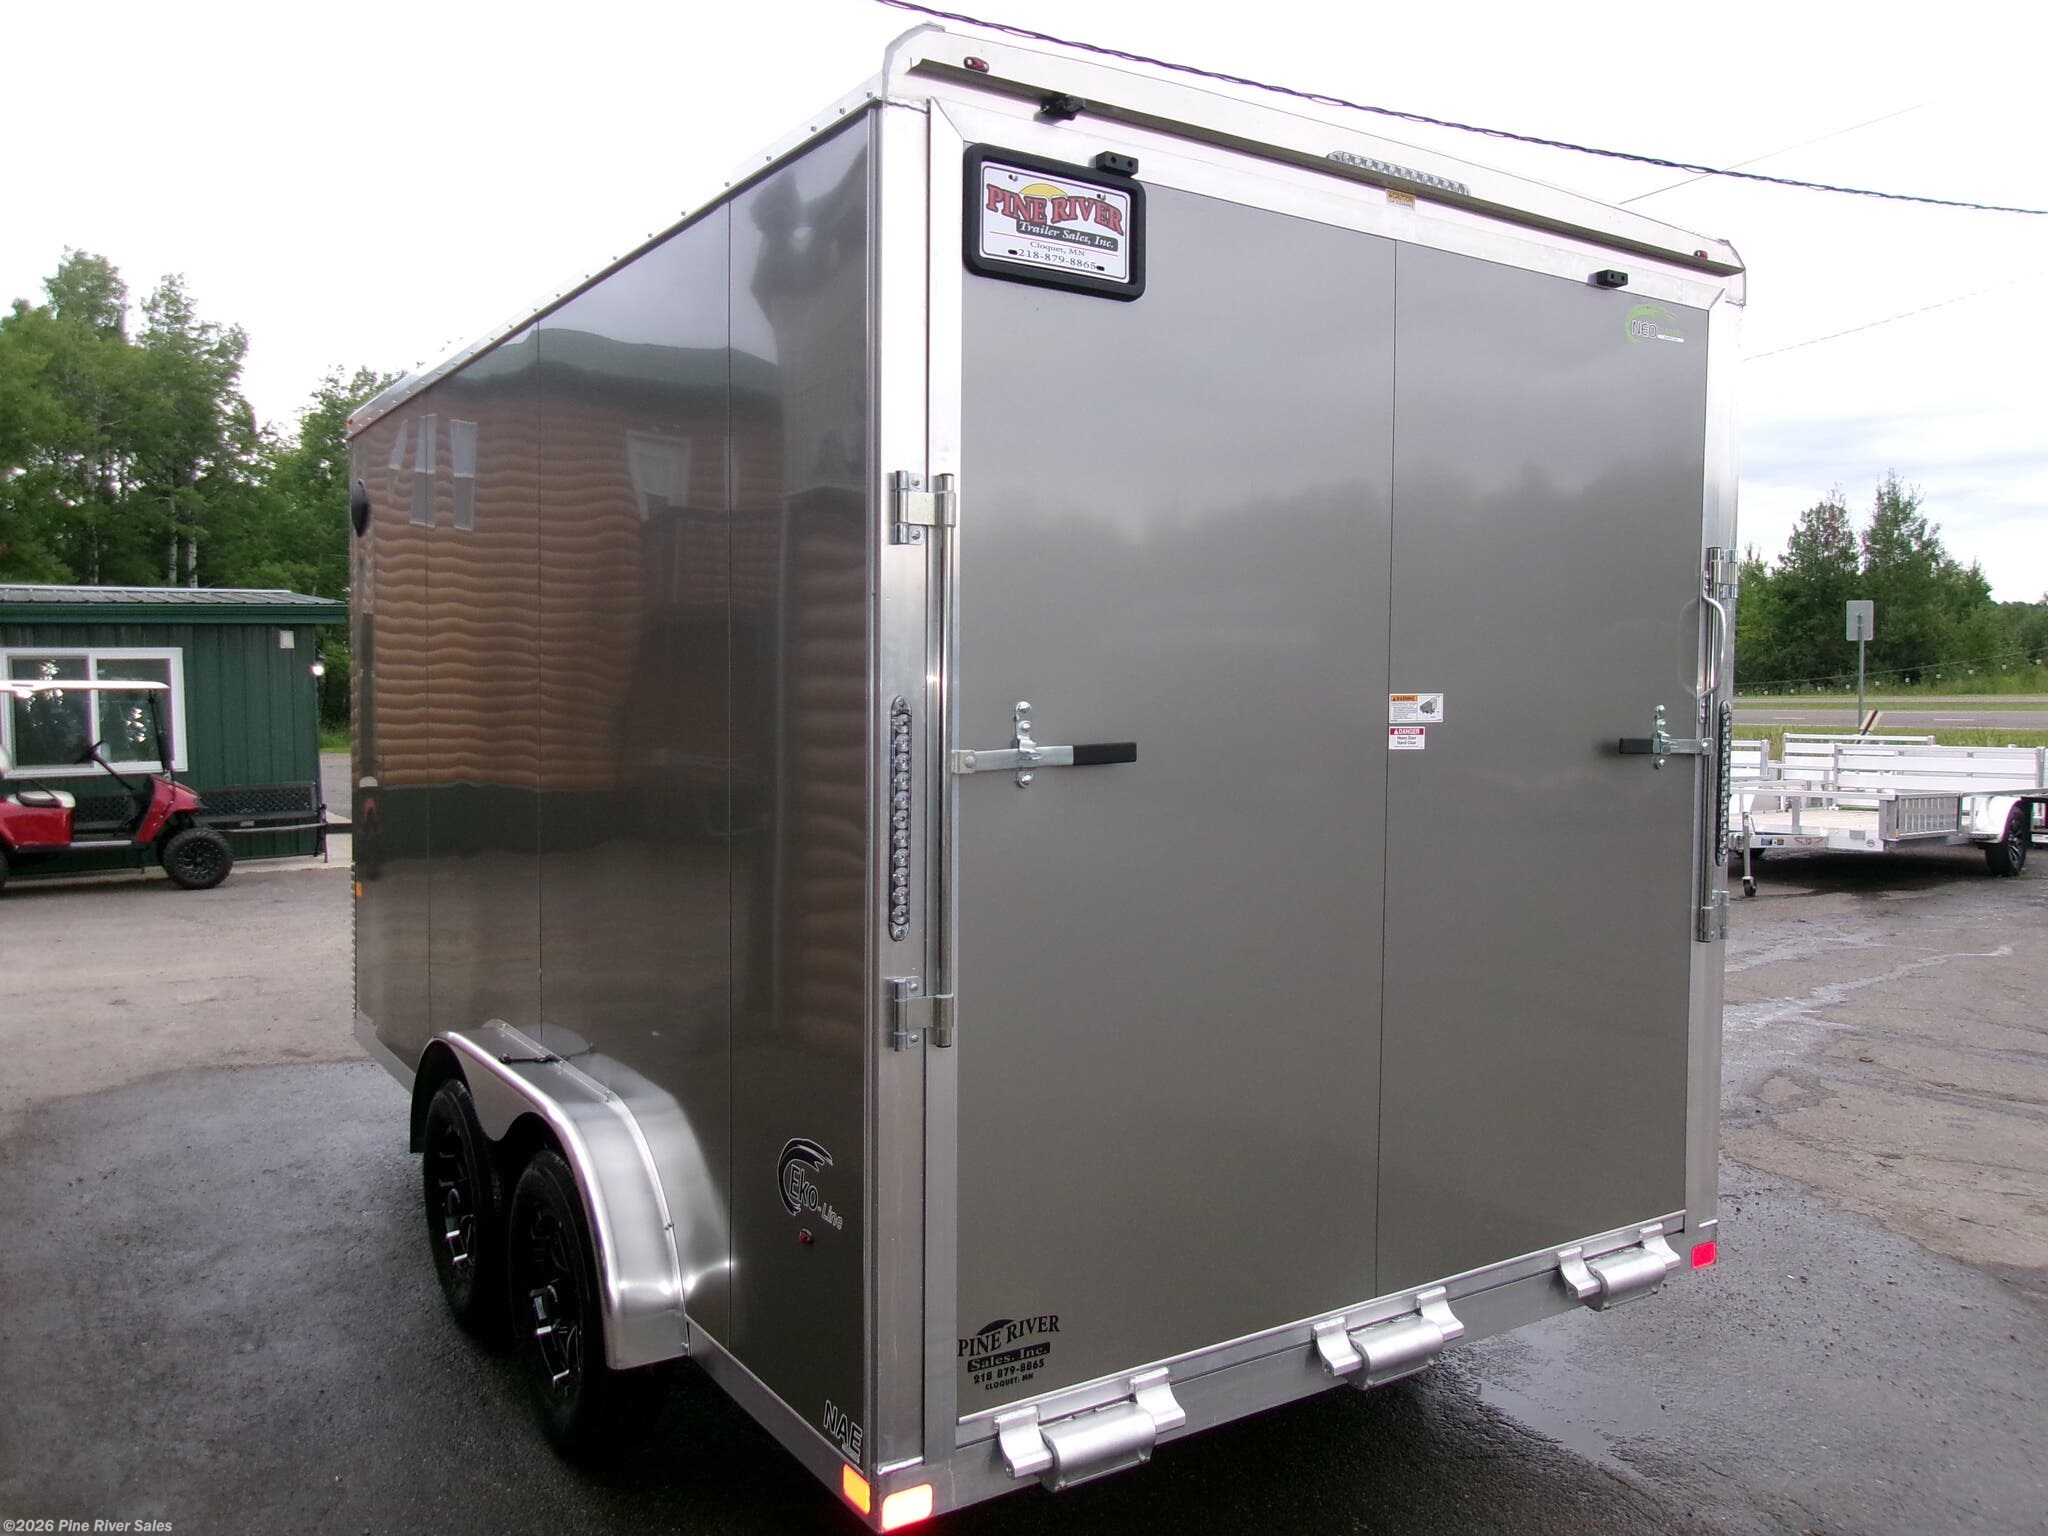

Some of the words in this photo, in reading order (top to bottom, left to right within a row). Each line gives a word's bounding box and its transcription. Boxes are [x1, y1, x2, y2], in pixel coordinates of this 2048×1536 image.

[986, 184, 1047, 224] PINE
[1050, 196, 1124, 236] RIVER
[1019, 221, 1060, 238] Trailer
[1062, 229, 1092, 245] Sales,
[1094, 237, 1114, 249] Inc.
[1017, 249, 1097, 269] 218-879-8865
[1030, 241, 1066, 255] Cloquet,
[1068, 248, 1086, 257] MN
[1631, 320, 1657, 339] NEO
[957, 1331, 1002, 1357] PINE
[1006, 1315, 1060, 1344] RIVER
[973, 1371, 992, 1384] 218
[997, 1358, 1045, 1378] 879-8865
